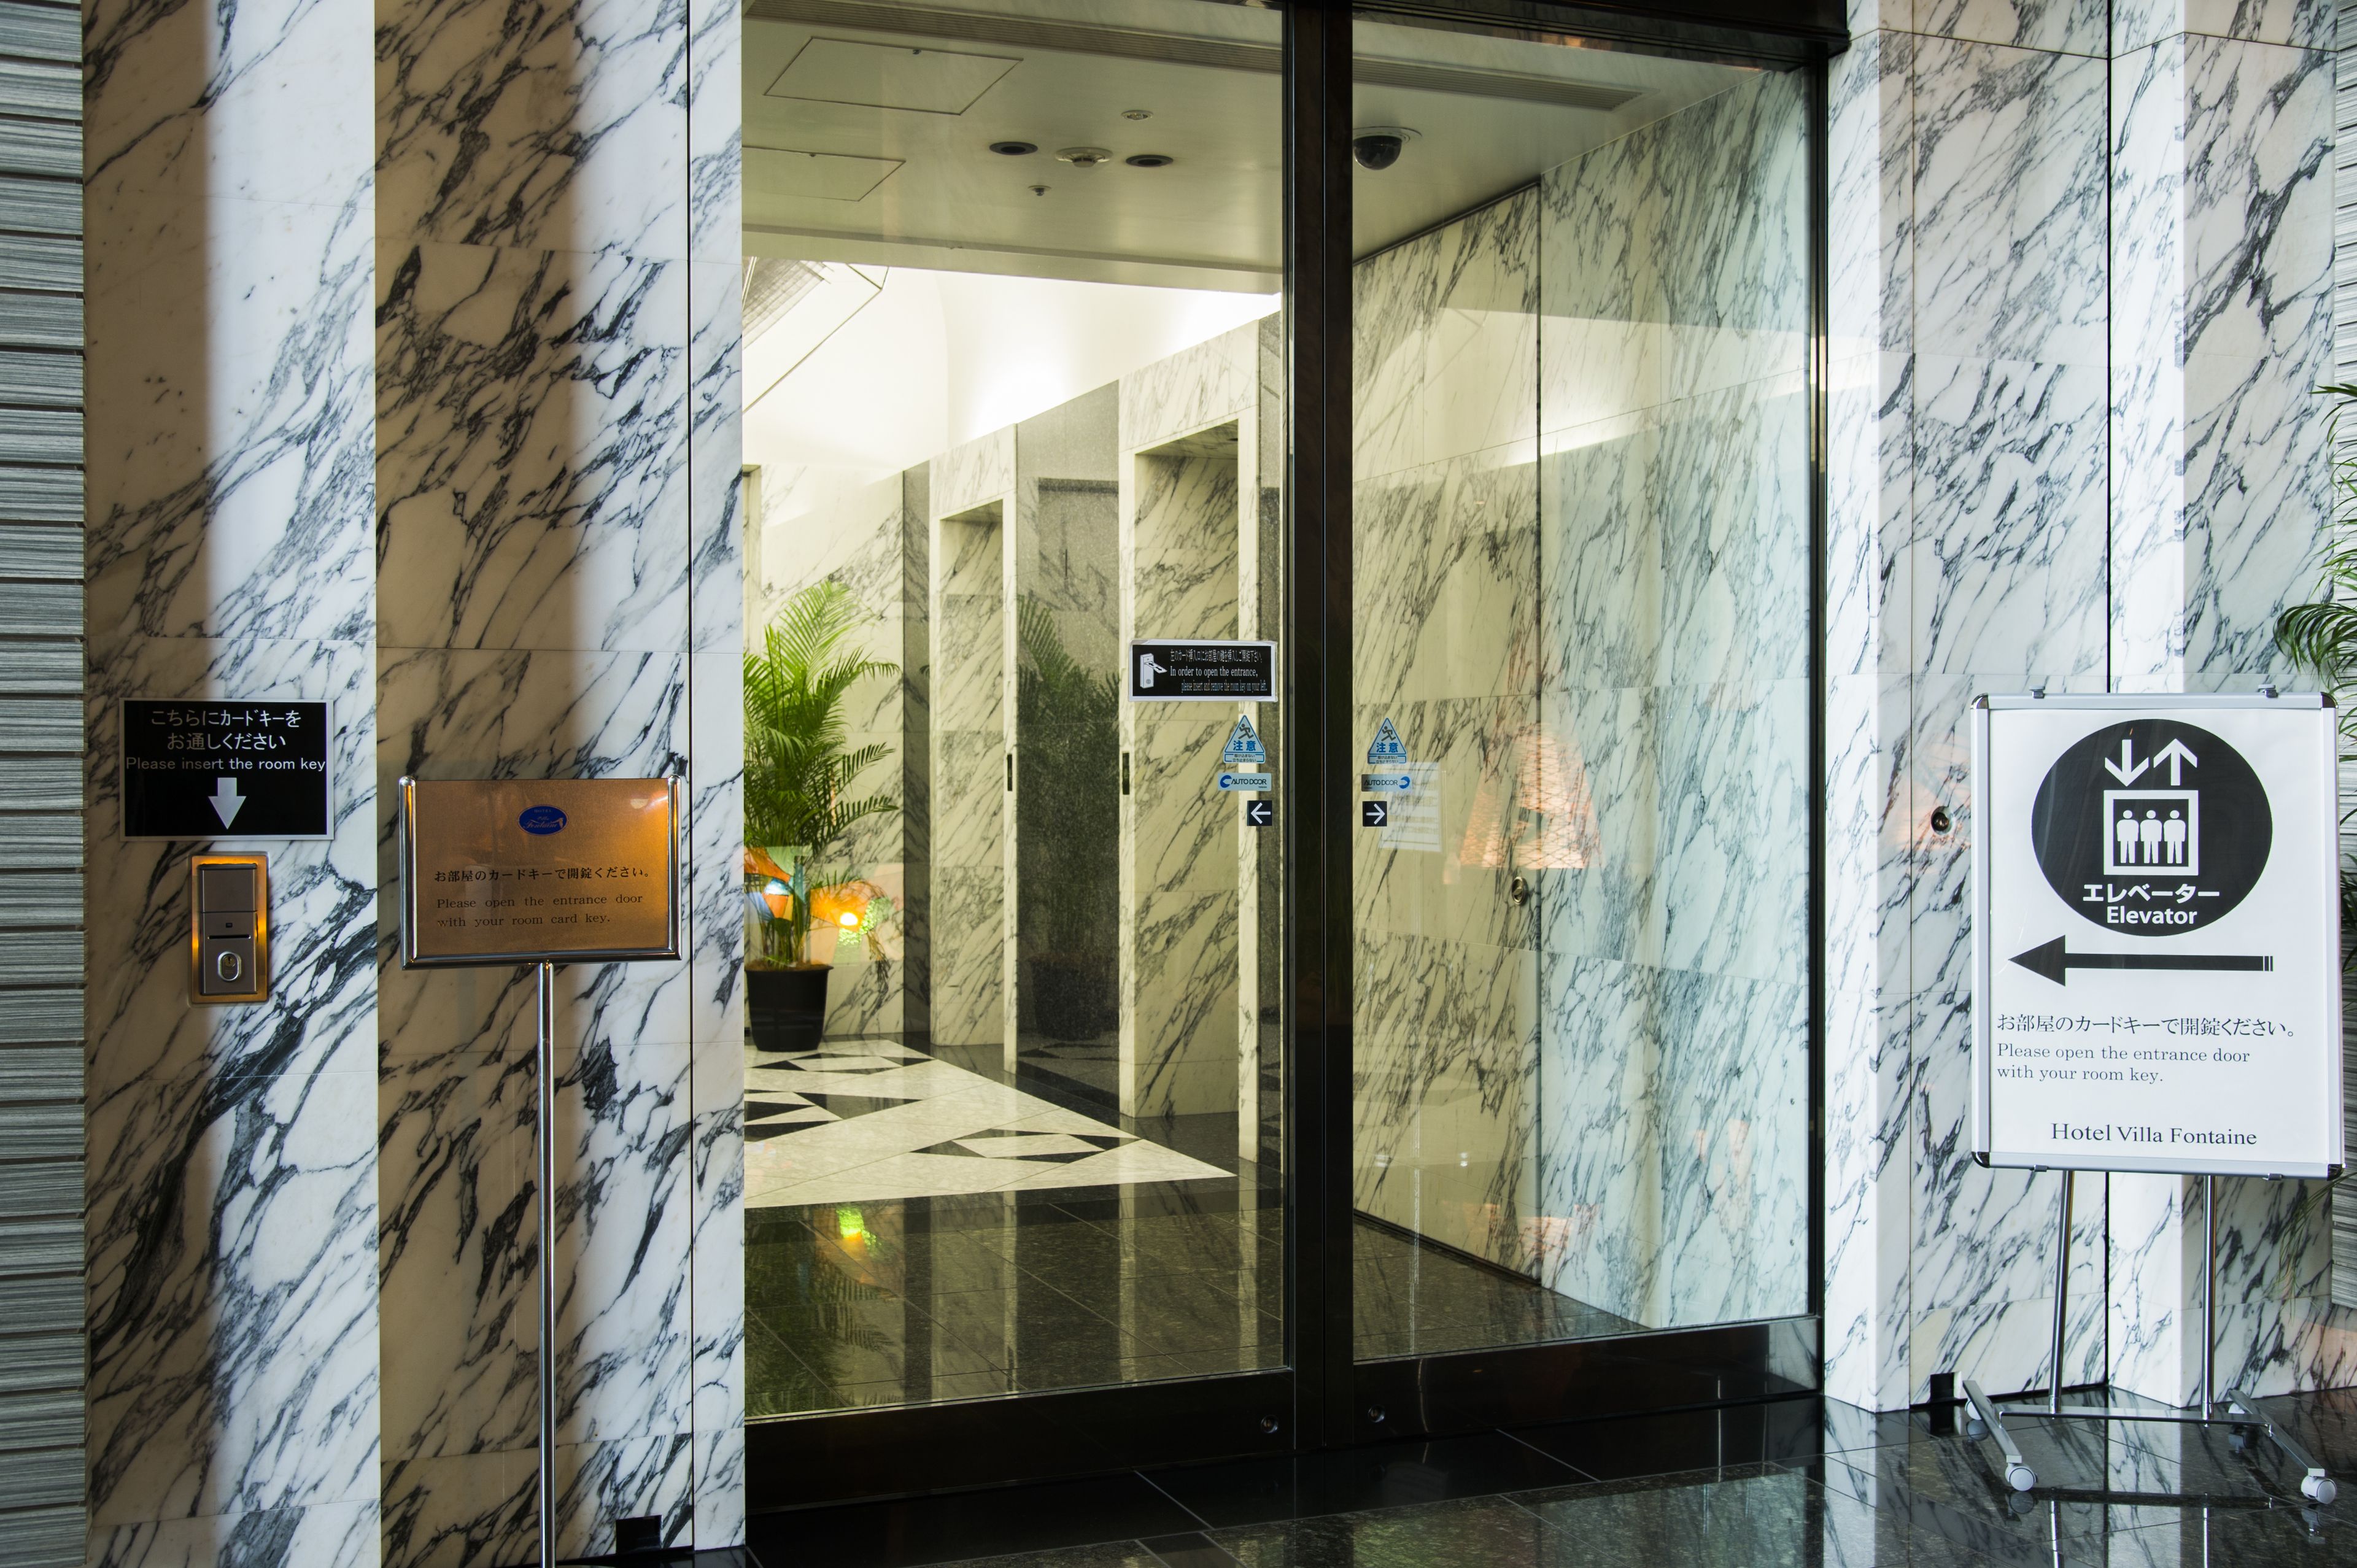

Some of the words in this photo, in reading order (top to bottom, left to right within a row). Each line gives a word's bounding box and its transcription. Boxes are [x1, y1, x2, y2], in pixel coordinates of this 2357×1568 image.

[1170, 666, 1176, 676] In
[1178, 666, 1194, 676] order
[1204, 668, 1218, 678] open
[1220, 666, 1229, 676] the
[1231, 667, 1258, 678] entrance,
[1181, 679, 1192, 693] please
[1193, 679, 1203, 691] insert
[152, 709, 301, 728] こちらにカードキーを
[168, 733, 286, 750] お通しください
[1233, 740, 1256, 751] 注意
[1377, 743, 1398, 752] 注意
[126, 757, 175, 770] Please
[182, 758, 224, 770] insert
[229, 758, 253, 770] the
[259, 761, 295, 770] room
[301, 758, 325, 772] key
[435, 867, 649, 882] お部屋のカードキーで開錠ください。
[437, 898, 476, 908] Please
[485, 898, 515, 909] open
[524, 896, 544, 906] the
[553, 897, 607, 905] entrance
[616, 894, 643, 903] door
[2083, 884, 2220, 903] エレベーター
[438, 917, 466, 927] with
[474, 918, 504, 928] your
[551, 914, 578, 924] card
[586, 913, 610, 924] key.
[2107, 905, 2197, 925] Elevator
[1997, 1013, 2294, 1037] お部屋のカードキーで開錠ください。
[1997, 1043, 2050, 1059] Please
[2056, 1048, 2094, 1060] open
[2102, 1046, 2127, 1060] the
[2134, 1049, 2207, 1062] entrance
[2213, 1048, 2250, 1062] door
[1997, 1065, 2034, 1079] with
[2039, 1069, 2077, 1082] your
[2082, 1070, 2124, 1081] room
[2129, 1068, 2163, 1084] key.
[2051, 1123, 2111, 1141] Hotel
[2118, 1126, 2163, 1144] Villa
[2170, 1127, 2258, 1145] Fontaine
